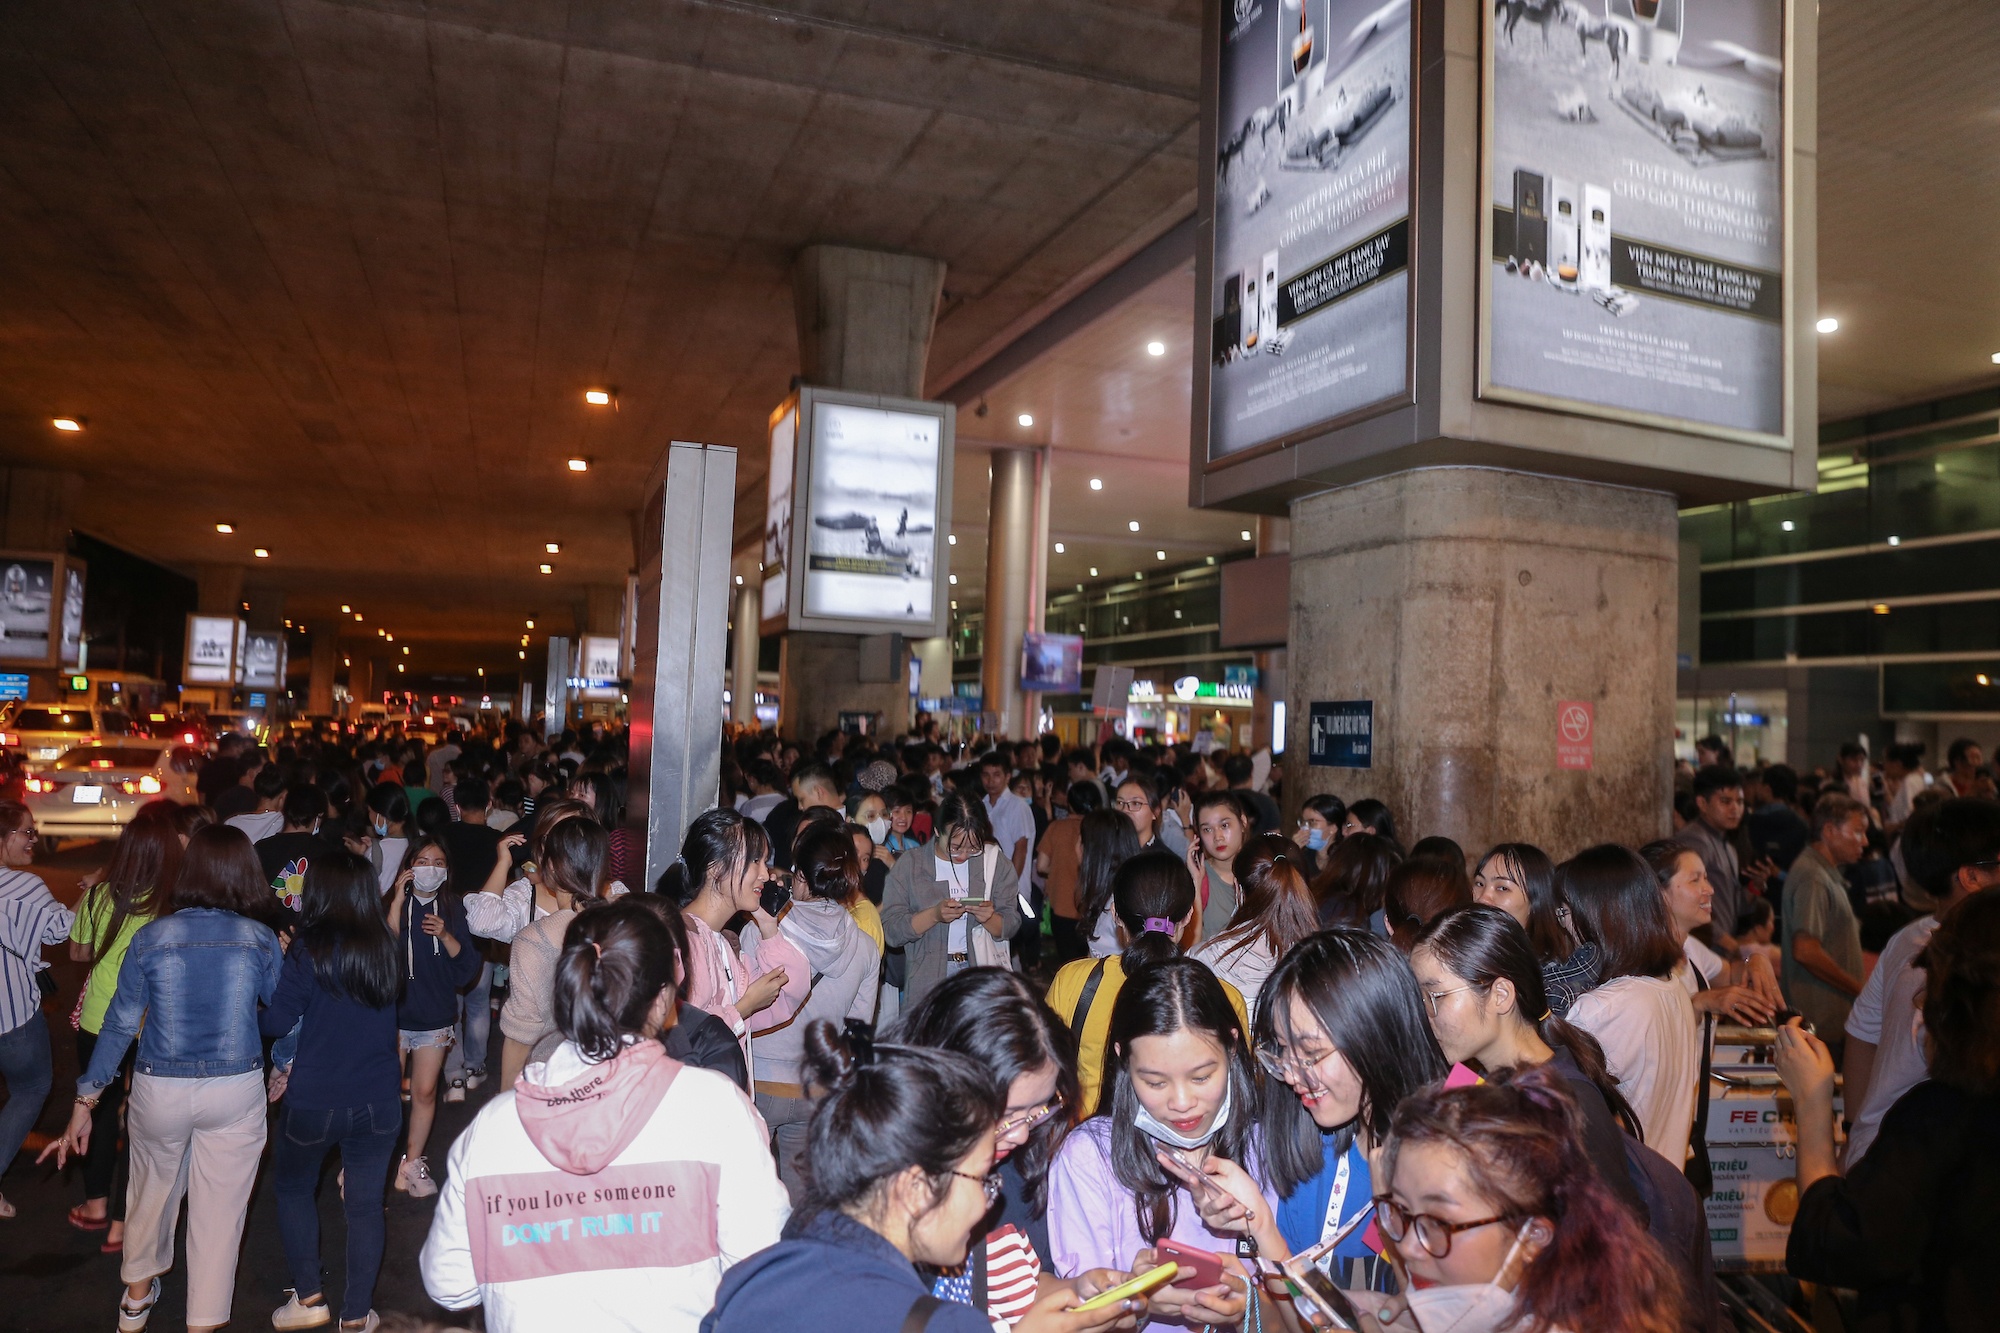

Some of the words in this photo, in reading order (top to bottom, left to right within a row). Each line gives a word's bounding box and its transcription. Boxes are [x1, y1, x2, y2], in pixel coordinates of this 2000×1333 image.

[1613, 178, 1645, 200] CHO
[1636, 263, 1672, 284] TRUNG
[1717, 281, 1756, 303] LEGEND
[570, 1076, 603, 1100] there
[1730, 1110, 1759, 1124] FE
[1711, 1158, 1748, 1173] TRIỆU
[488, 1195, 502, 1214] if
[508, 1196, 539, 1216] you
[546, 1190, 587, 1209] love
[594, 1184, 676, 1203] someone
[1708, 1188, 1745, 1203] TRIỆU
[503, 1219, 573, 1247] DON'T
[582, 1213, 634, 1237] RUIN
[641, 1212, 663, 1234] IT
